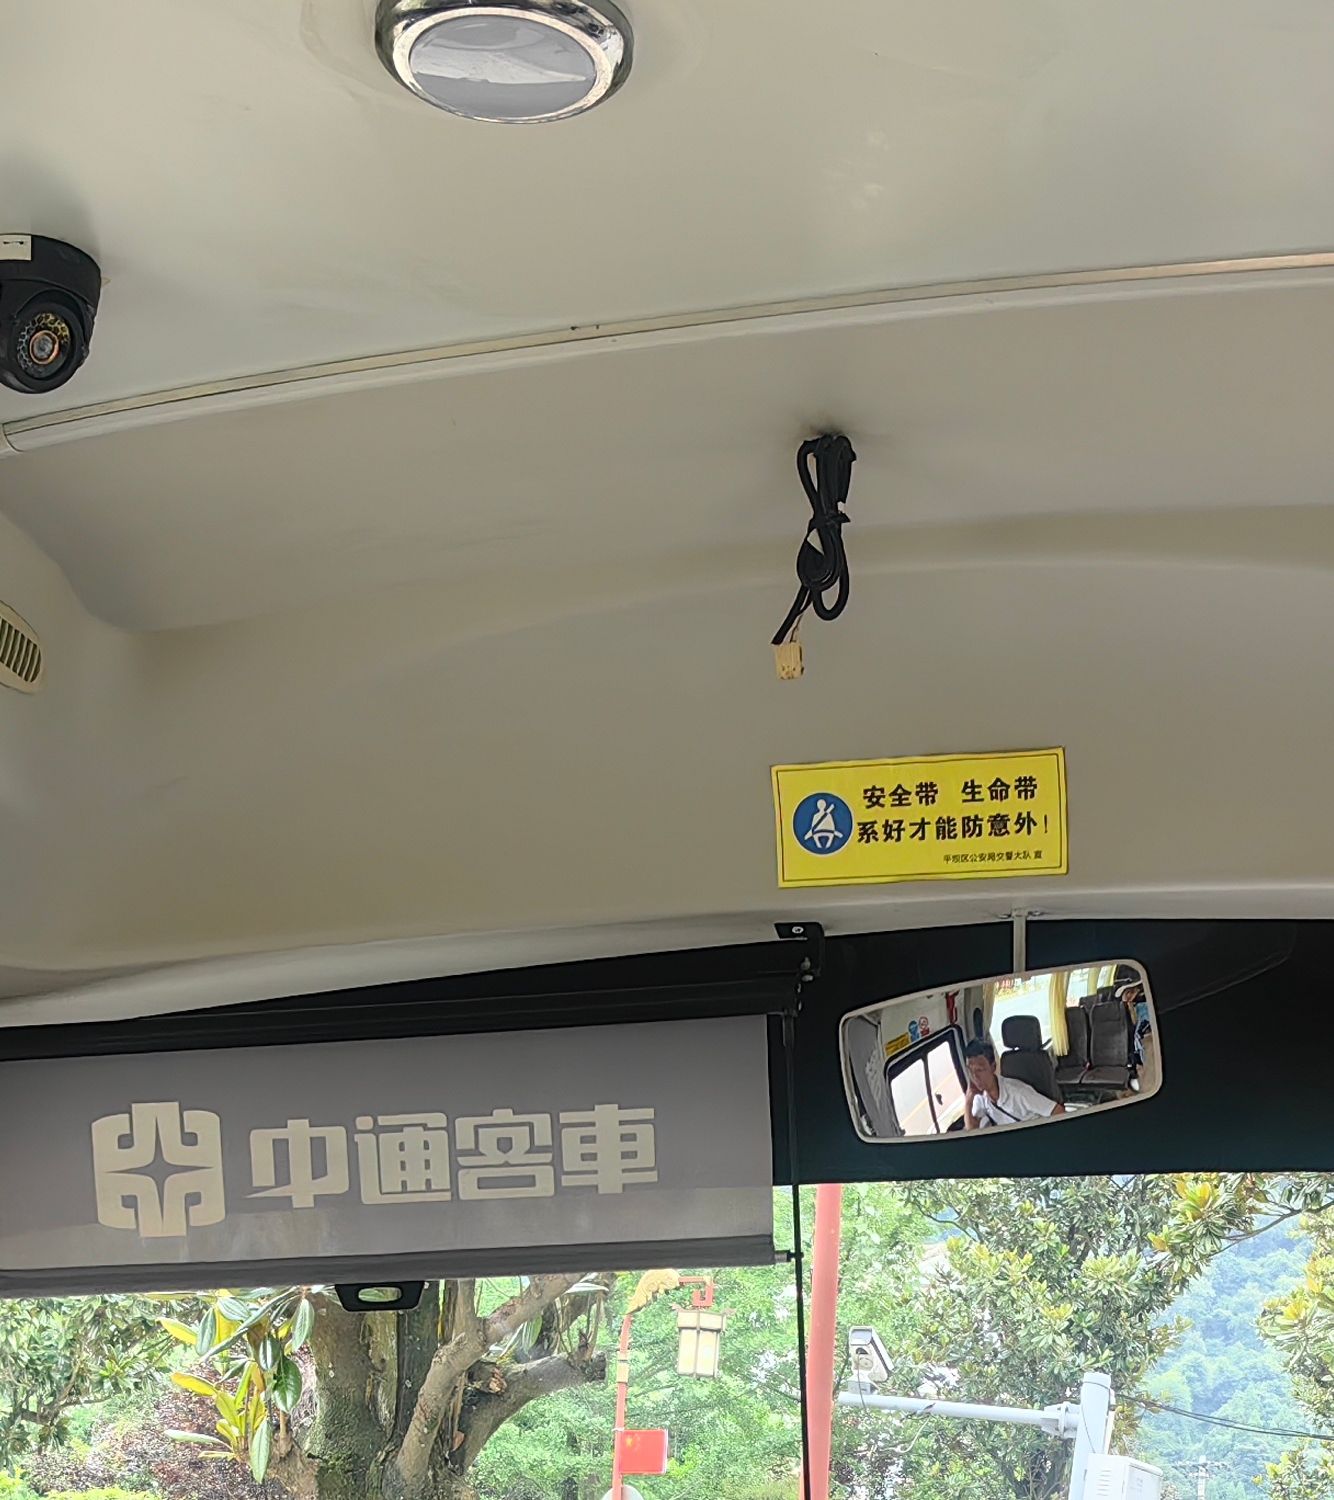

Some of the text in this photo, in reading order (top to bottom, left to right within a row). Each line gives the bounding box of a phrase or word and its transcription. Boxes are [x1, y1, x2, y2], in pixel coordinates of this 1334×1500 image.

[863, 775, 1038, 809] 安全带 生命带
